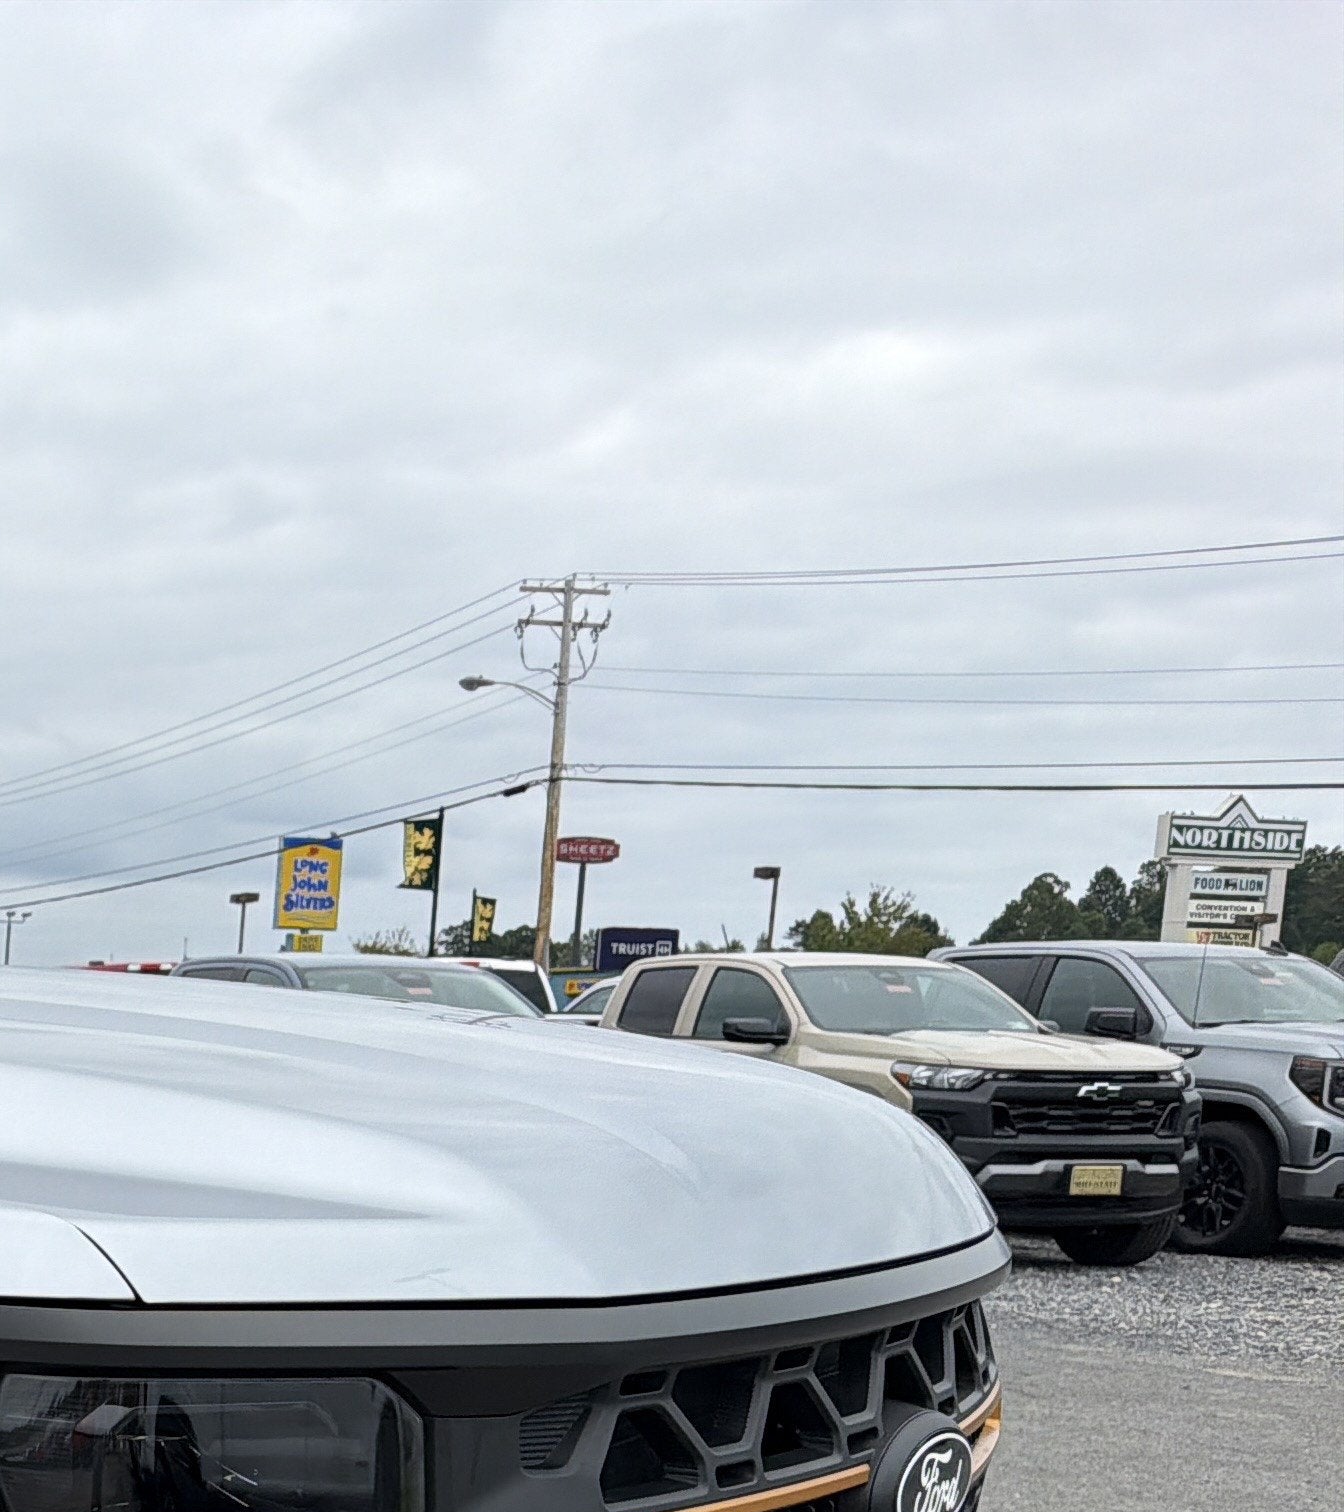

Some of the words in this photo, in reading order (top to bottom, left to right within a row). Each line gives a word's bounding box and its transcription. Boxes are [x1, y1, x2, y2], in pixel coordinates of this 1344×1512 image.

[1169, 826, 1303, 851] NORTHSIDE
[293, 859, 329, 875] LONG
[1193, 877, 1223, 891] FOOD
[1238, 878, 1264, 892] LION
[610, 942, 656, 956] TRUIST
